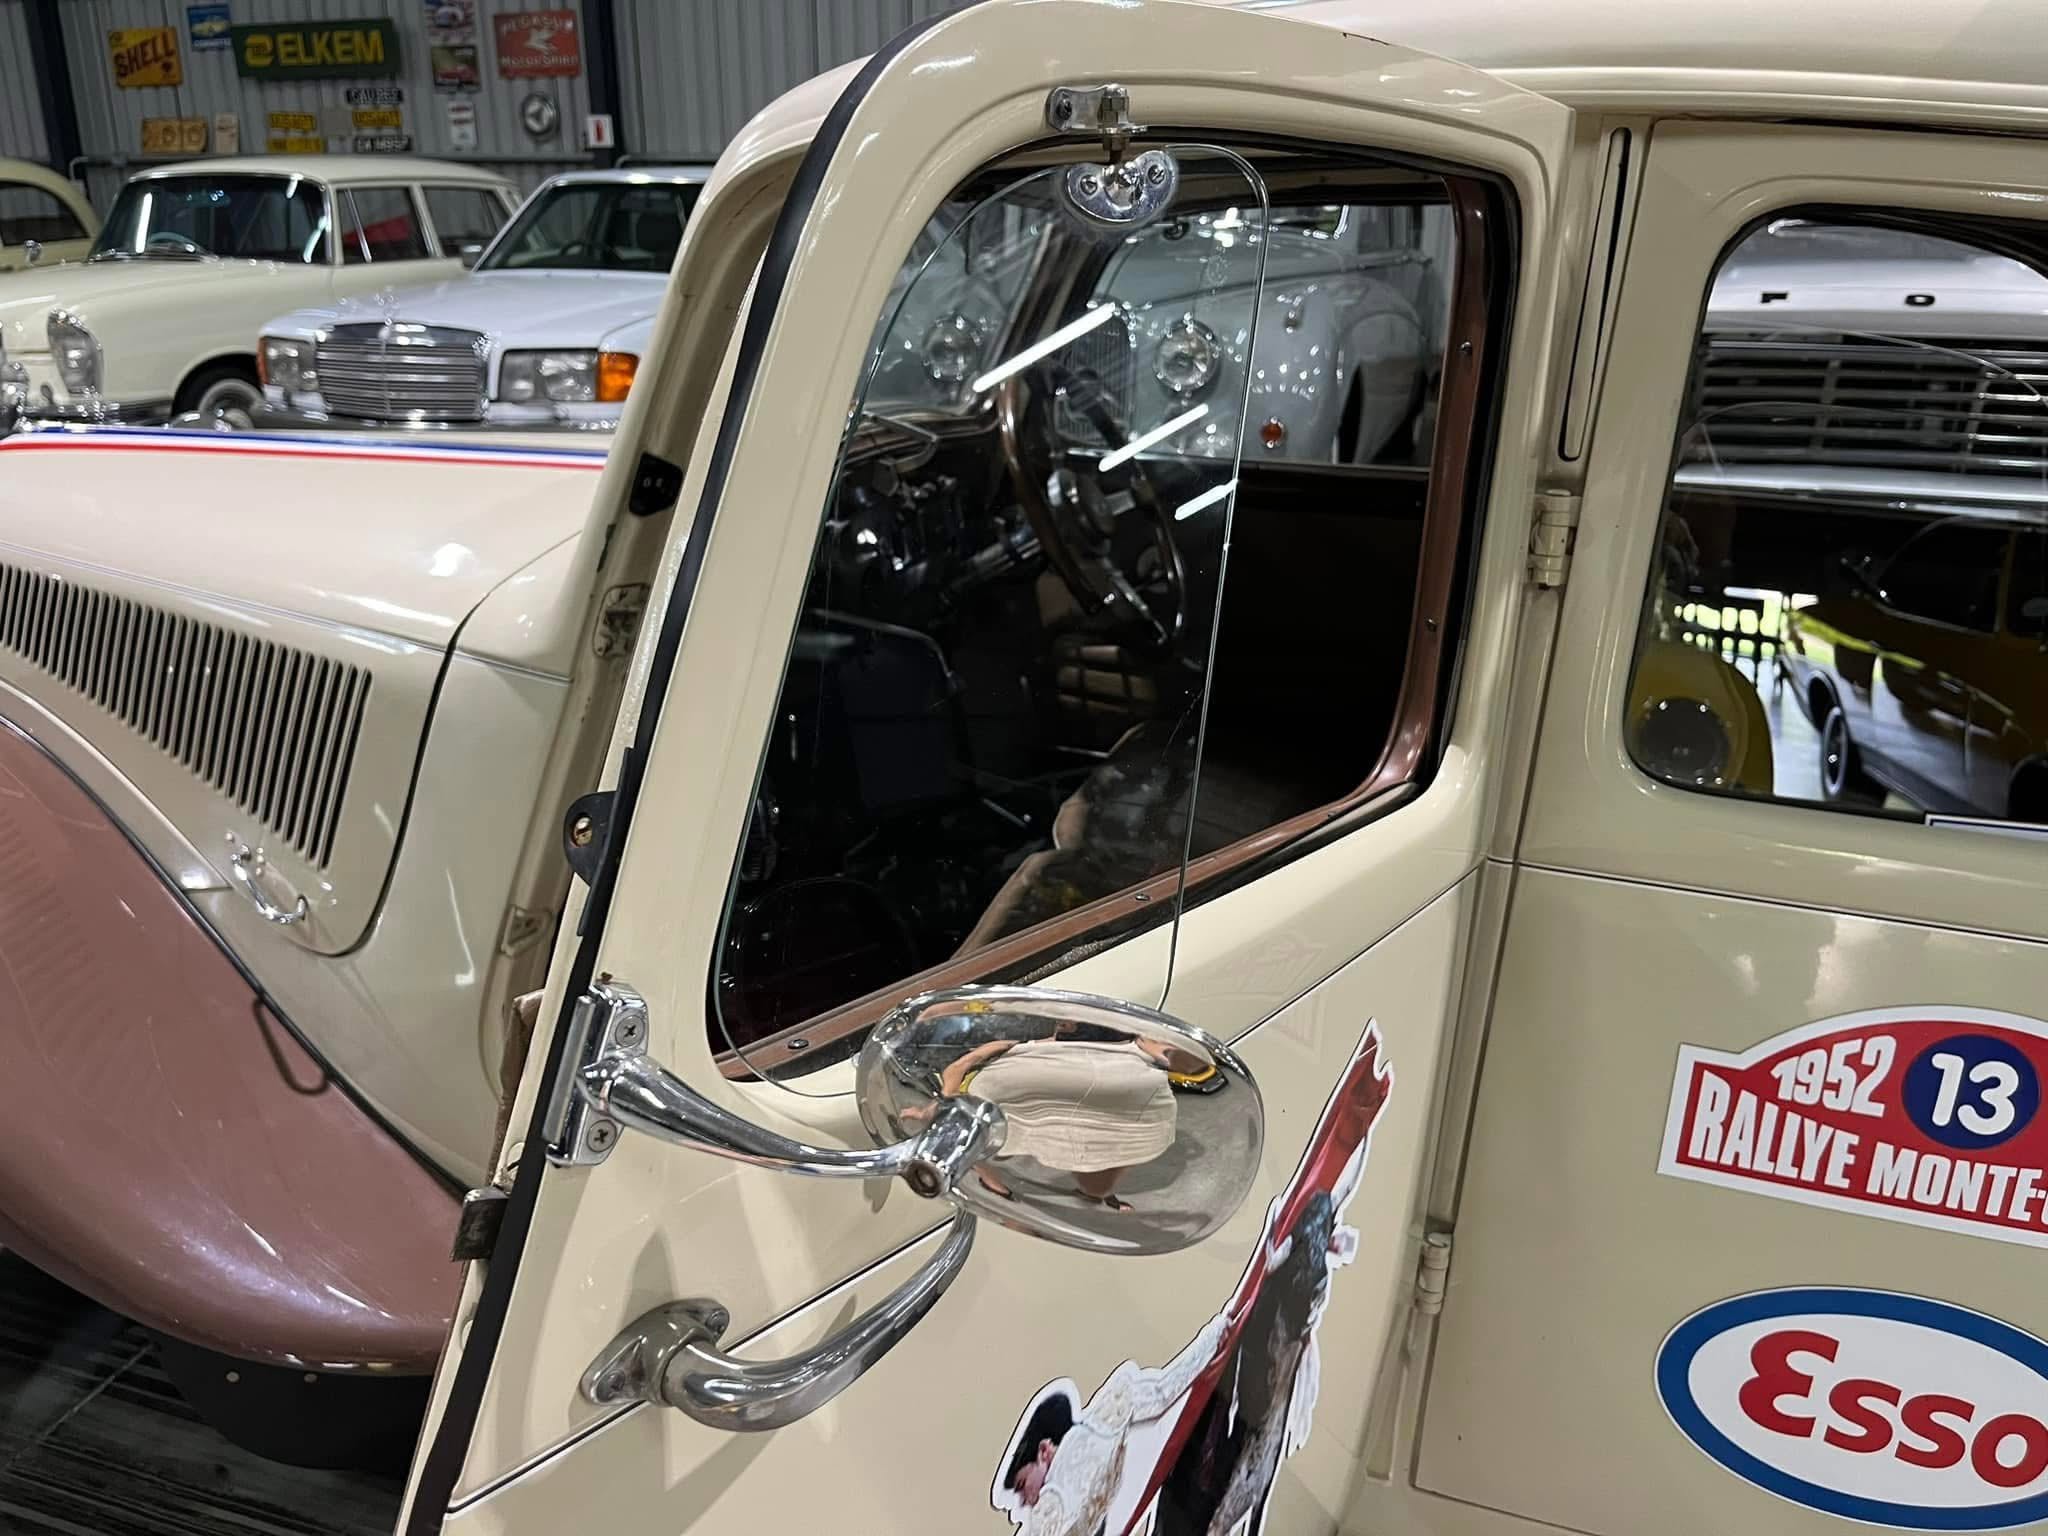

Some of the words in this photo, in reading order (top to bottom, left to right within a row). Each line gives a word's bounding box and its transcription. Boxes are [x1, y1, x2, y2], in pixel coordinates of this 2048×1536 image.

[114, 32, 176, 77] SHELL
[276, 29, 385, 66] ELKEM
[1771, 1035, 1897, 1117] 1952
[1931, 1052, 2020, 1136] 13
[1688, 1070, 1861, 1188] RALLYE
